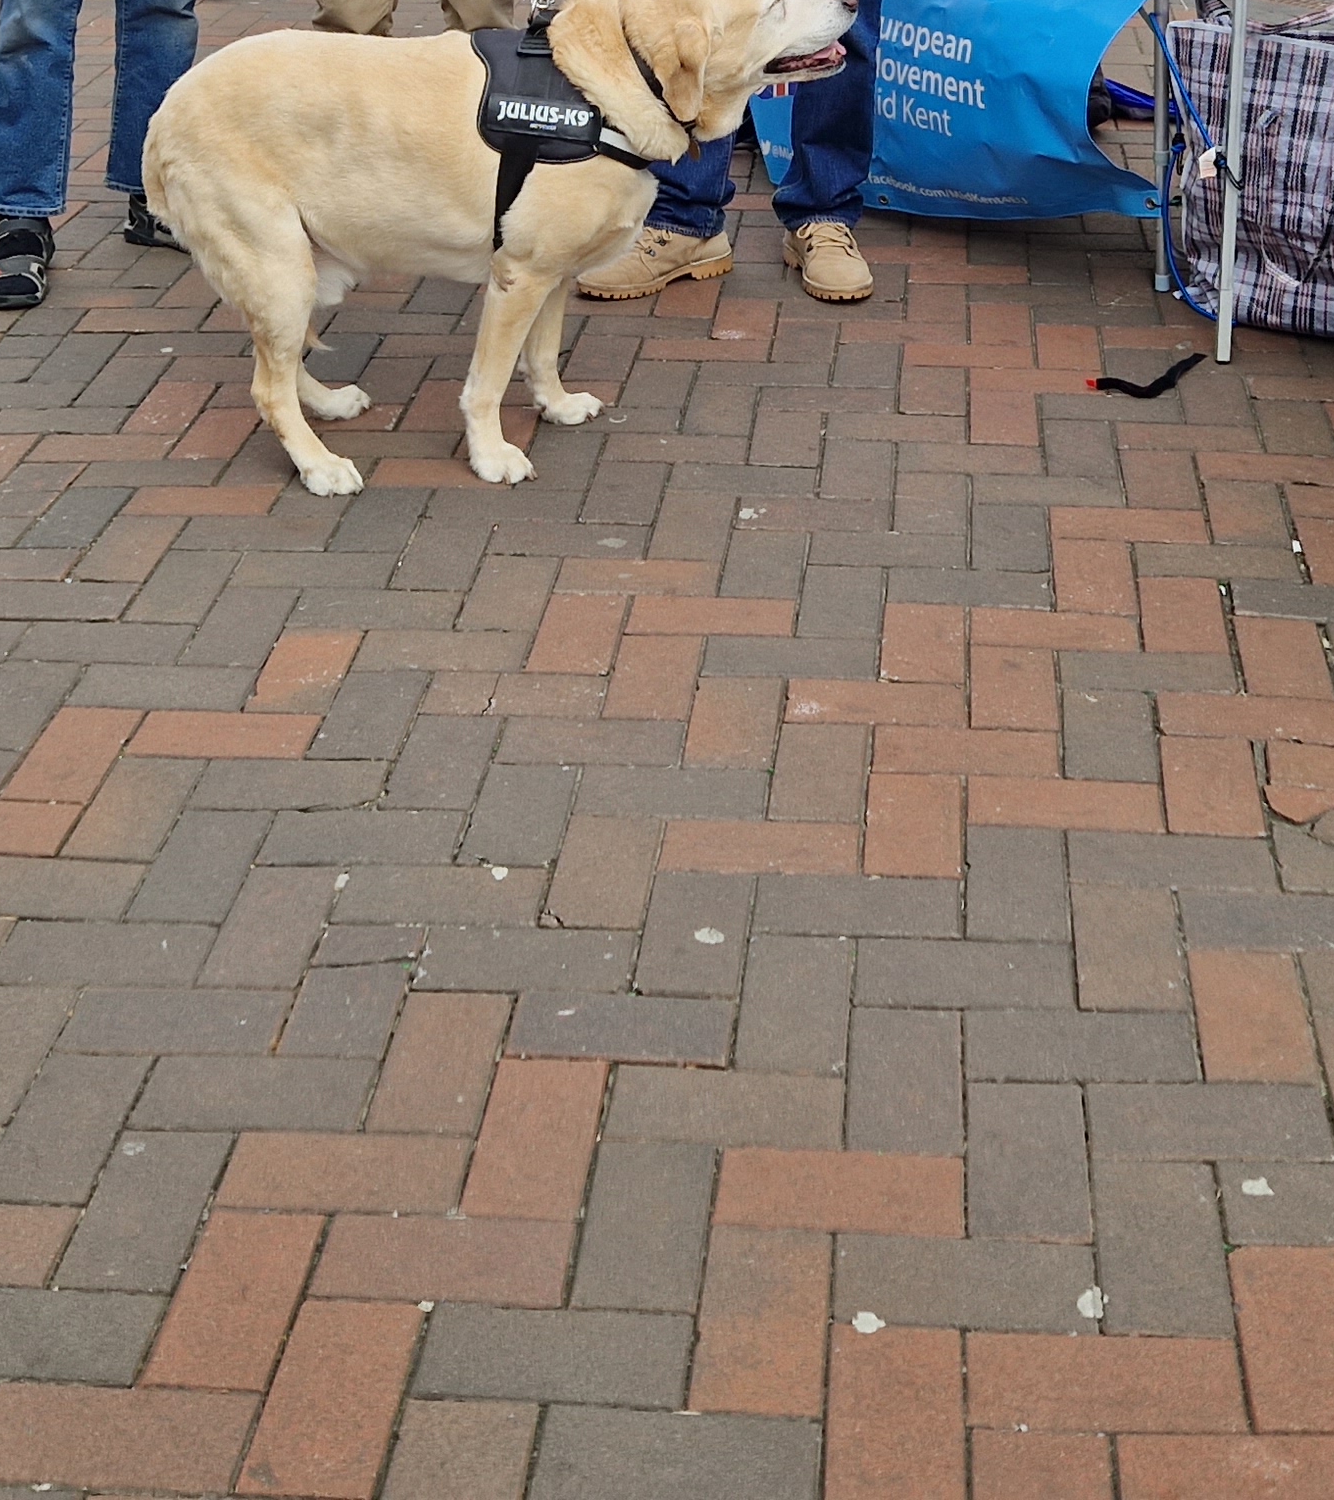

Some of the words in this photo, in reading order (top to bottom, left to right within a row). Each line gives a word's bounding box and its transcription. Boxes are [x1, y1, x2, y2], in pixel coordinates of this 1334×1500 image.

[880, 16, 971, 64] uropean
[876, 47, 986, 109] ovement
[875, 87, 896, 120] id
[903, 95, 952, 137] Kent
